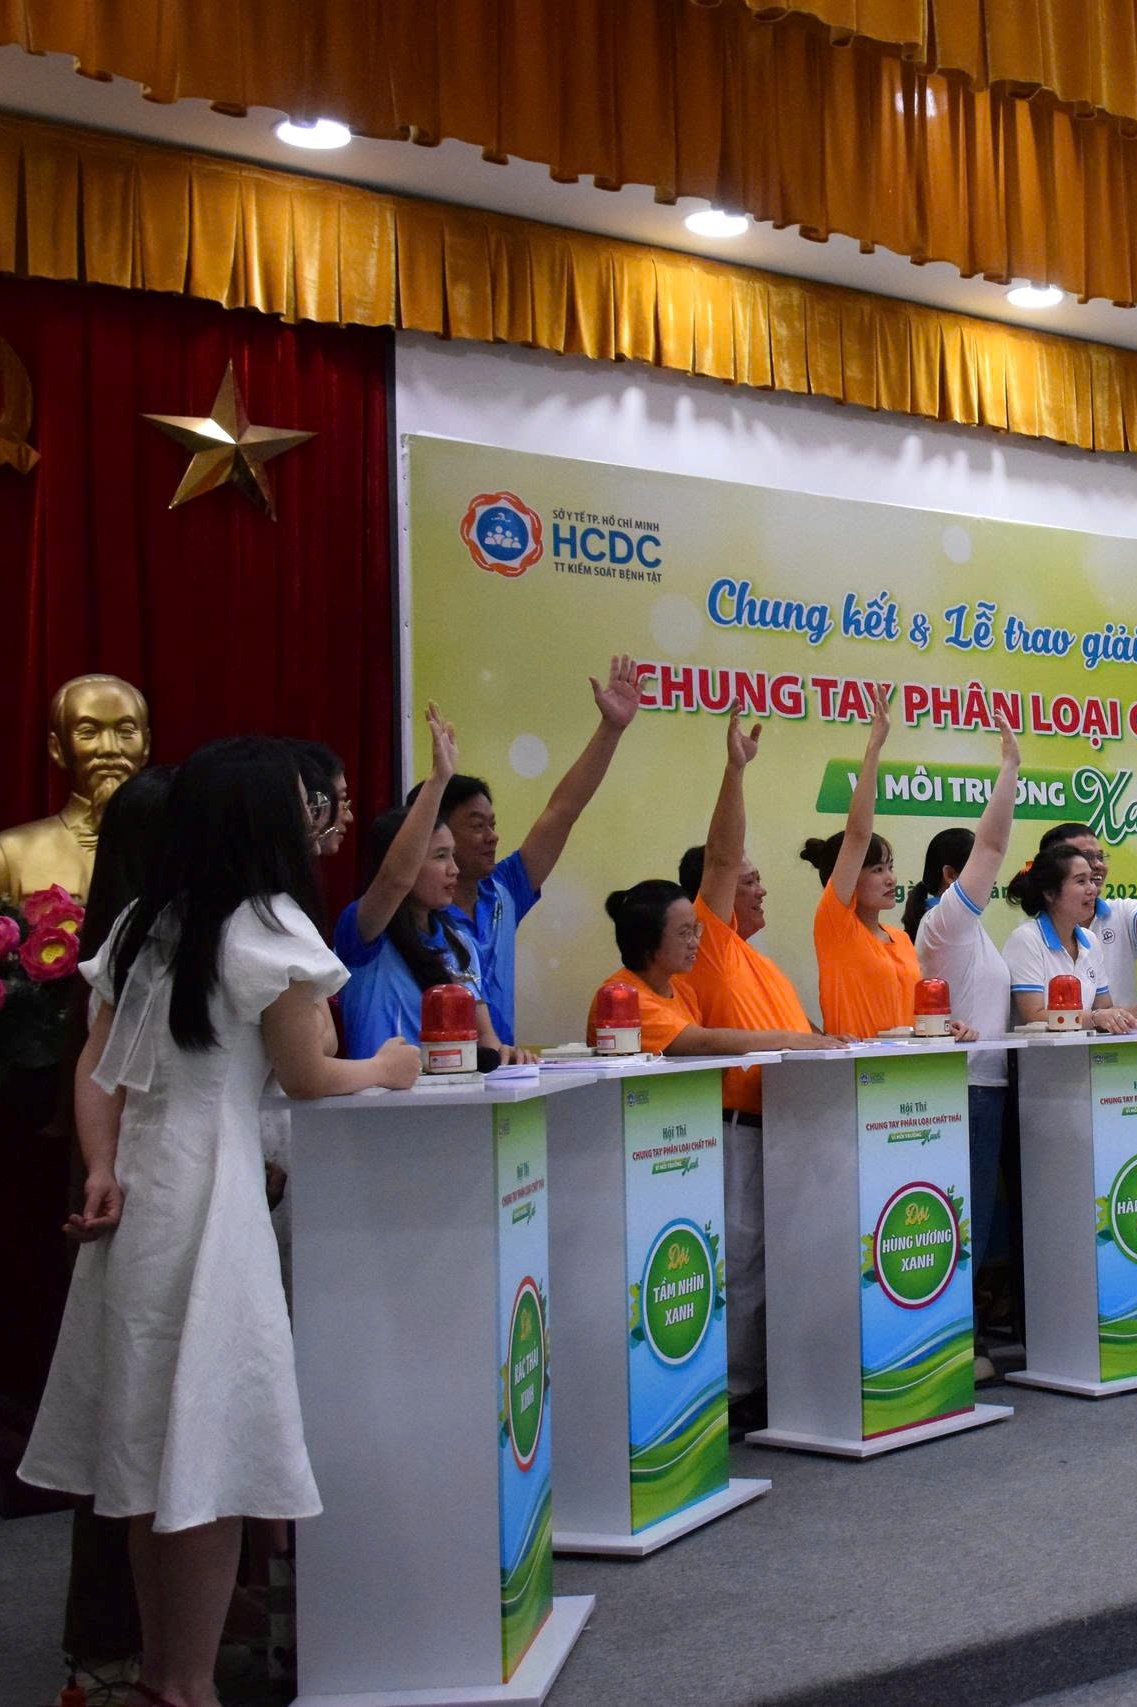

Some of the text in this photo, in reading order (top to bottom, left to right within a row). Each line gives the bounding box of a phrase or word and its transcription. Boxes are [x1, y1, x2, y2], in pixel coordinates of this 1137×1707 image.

[553, 509, 565, 520] SỞ
[567, 512, 573, 520] Y
[574, 510, 585, 522] TẾ
[602, 514, 616, 527] HỒ
[617, 516, 633, 529] CHÍ
[635, 520, 659, 532] MINH
[553, 523, 662, 568] HCDC
[553, 562, 662, 585] TT KIỂM SOÁT BỆNH TẬT
[707, 578, 833, 644] Chung
[842, 591, 899, 639] kết
[909, 612, 931, 648] &
[944, 601, 997, 648] Lễ
[1005, 615, 1075, 655] trao
[636, 664, 802, 715] CHUNG
[903, 682, 1021, 731] PHÂN
[1031, 694, 1121, 747] LOẠI
[885, 765, 942, 801] MÔI
[882, 1228, 952, 1253] HÙNG VƯƠNG
[901, 1253, 935, 1272] XANH
[653, 1271, 705, 1304] TẦM NHÌN
[664, 1302, 694, 1327] XANH
